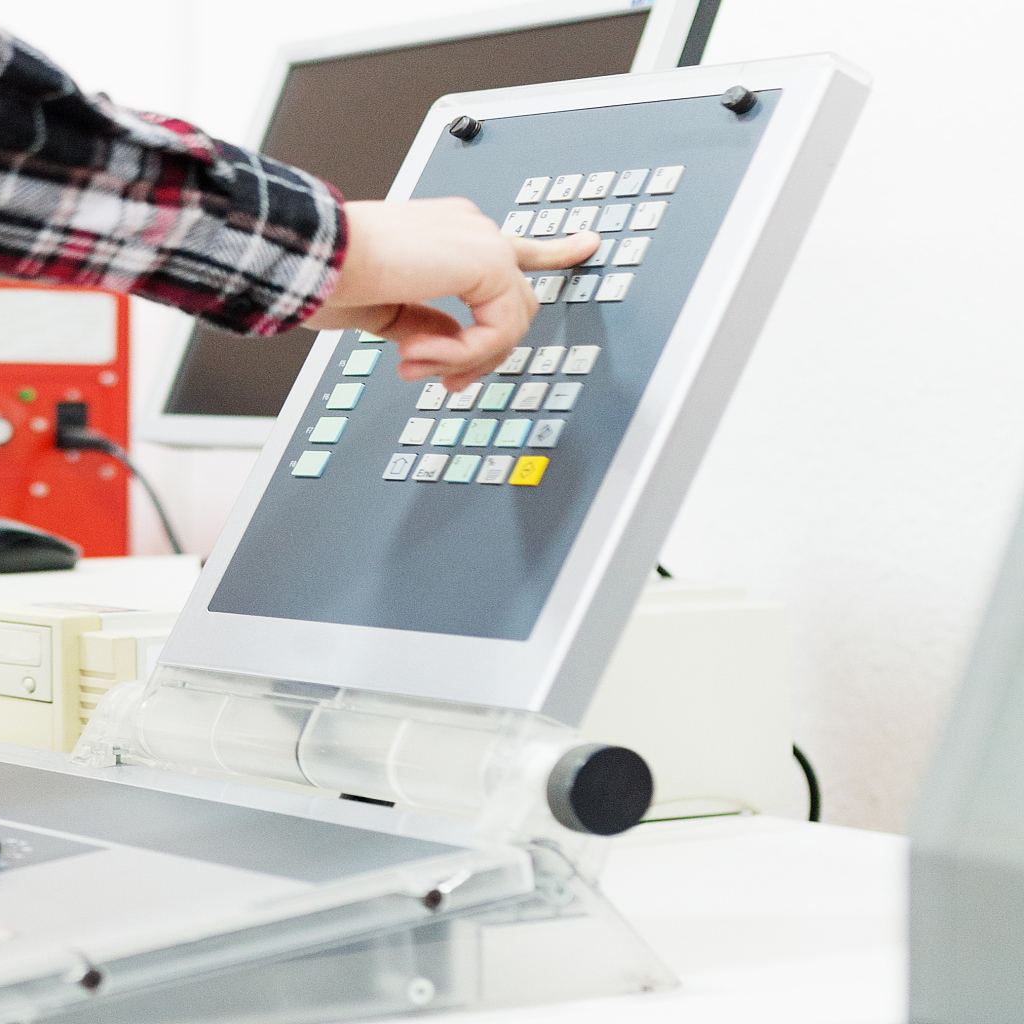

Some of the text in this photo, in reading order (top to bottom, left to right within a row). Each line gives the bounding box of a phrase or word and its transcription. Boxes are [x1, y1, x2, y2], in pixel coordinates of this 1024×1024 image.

[623, 171, 632, 180] D
[656, 168, 665, 177] E
[525, 179, 532, 187] A
[557, 176, 565, 185] B
[589, 174, 598, 183] C
[531, 190, 538, 199] 7
[562, 187, 571, 197] 8
[595, 185, 604, 195] 9
[508, 212, 517, 220] F
[540, 211, 549, 219] G
[572, 208, 581, 216] H
[515, 224, 523, 234] 4
[546, 223, 555, 232] 5
[580, 220, 588, 230] 6
[538, 278, 547, 286] R
[572, 277, 580, 285] S
[538, 348, 546, 357] X
[425, 384, 433, 393] Z
[416, 468, 436, 477] End
